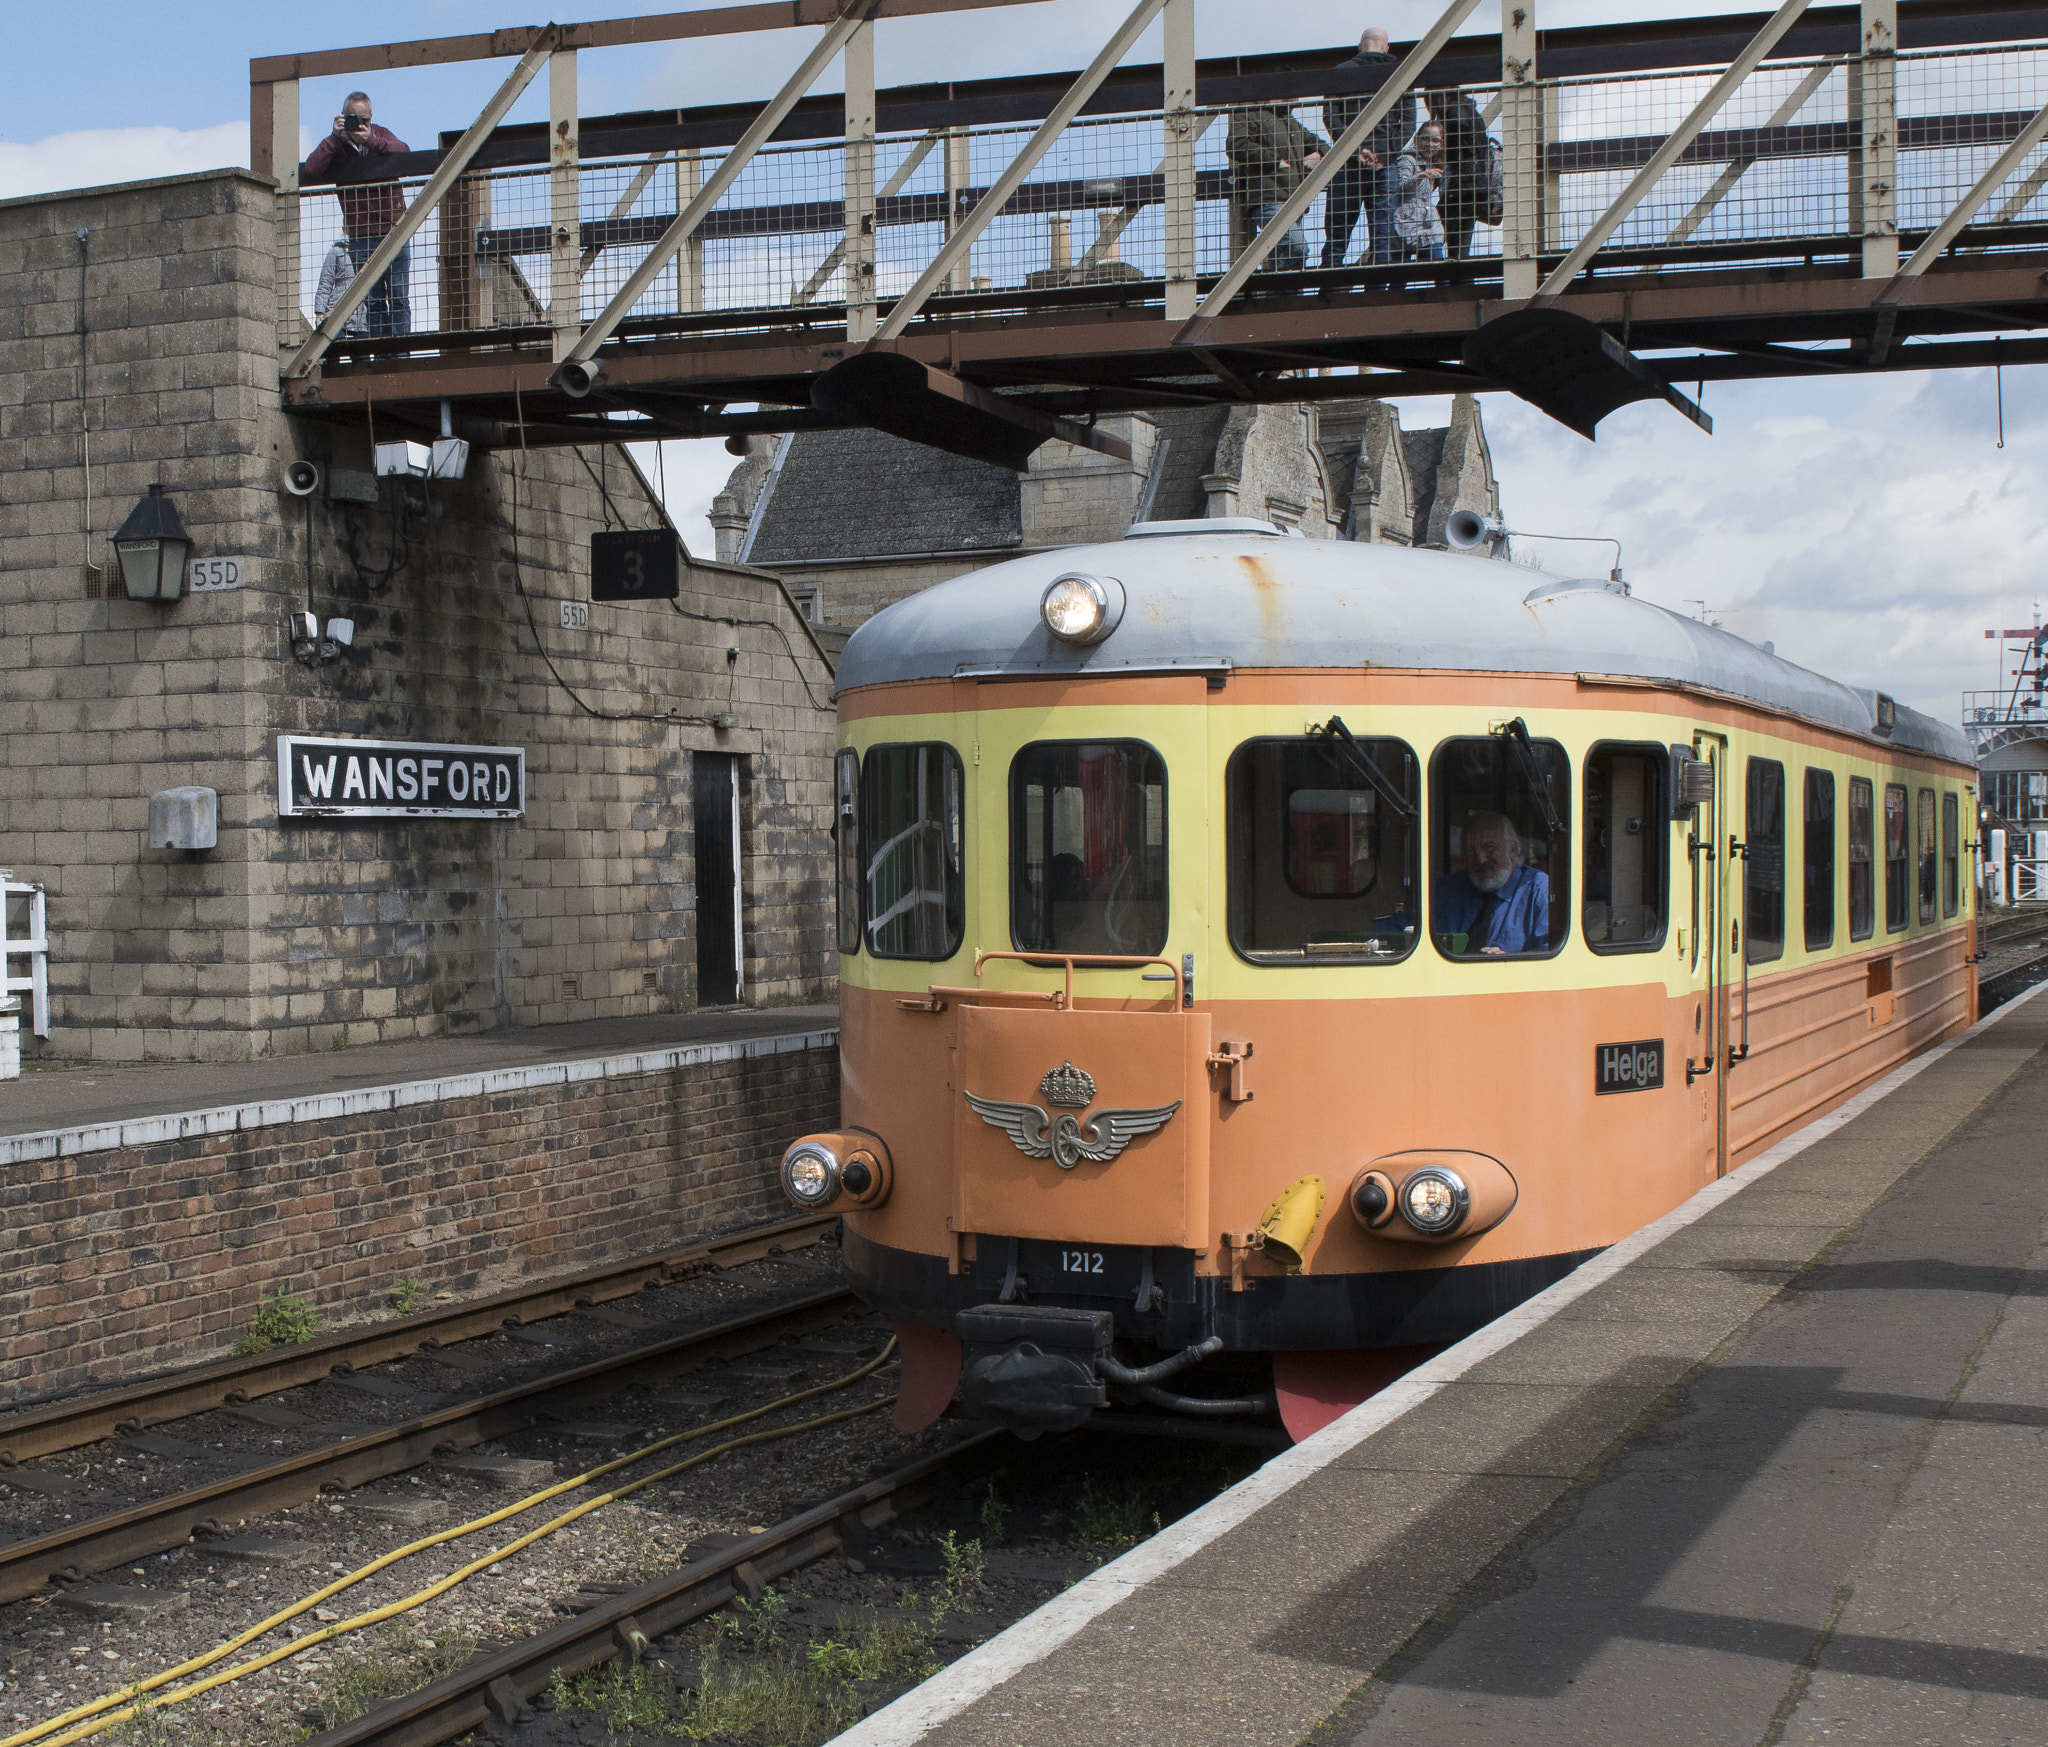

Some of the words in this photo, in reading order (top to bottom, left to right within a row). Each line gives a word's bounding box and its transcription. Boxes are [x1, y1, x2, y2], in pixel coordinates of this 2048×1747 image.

[119, 541, 157, 550] WANSFORD
[194, 562, 239, 587] 55D
[622, 551, 645, 591] 3
[563, 605, 587, 626] 55D
[302, 754, 511, 803] WANSFORD
[1603, 1045, 1658, 1086] Helga
[1062, 1251, 1104, 1274] 1212
